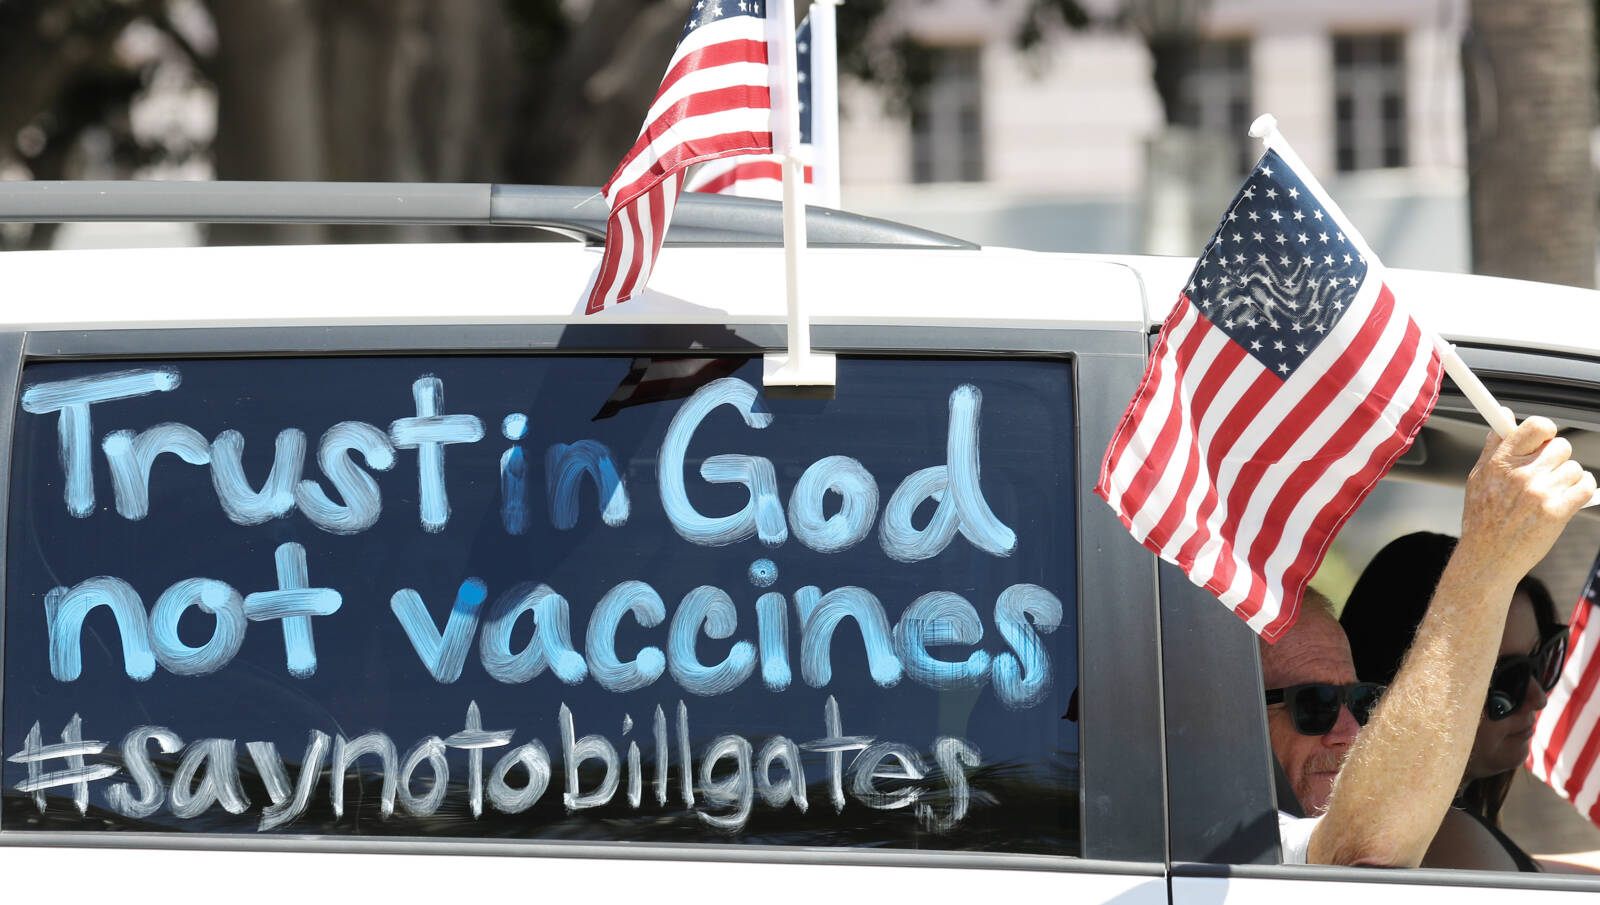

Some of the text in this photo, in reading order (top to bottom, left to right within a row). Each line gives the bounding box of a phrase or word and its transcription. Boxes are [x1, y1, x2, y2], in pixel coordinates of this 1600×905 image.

[22, 366, 1017, 563] Trust in God
[44, 541, 1063, 708] not vaccines
[7, 694, 985, 834] #saynotobillgates
